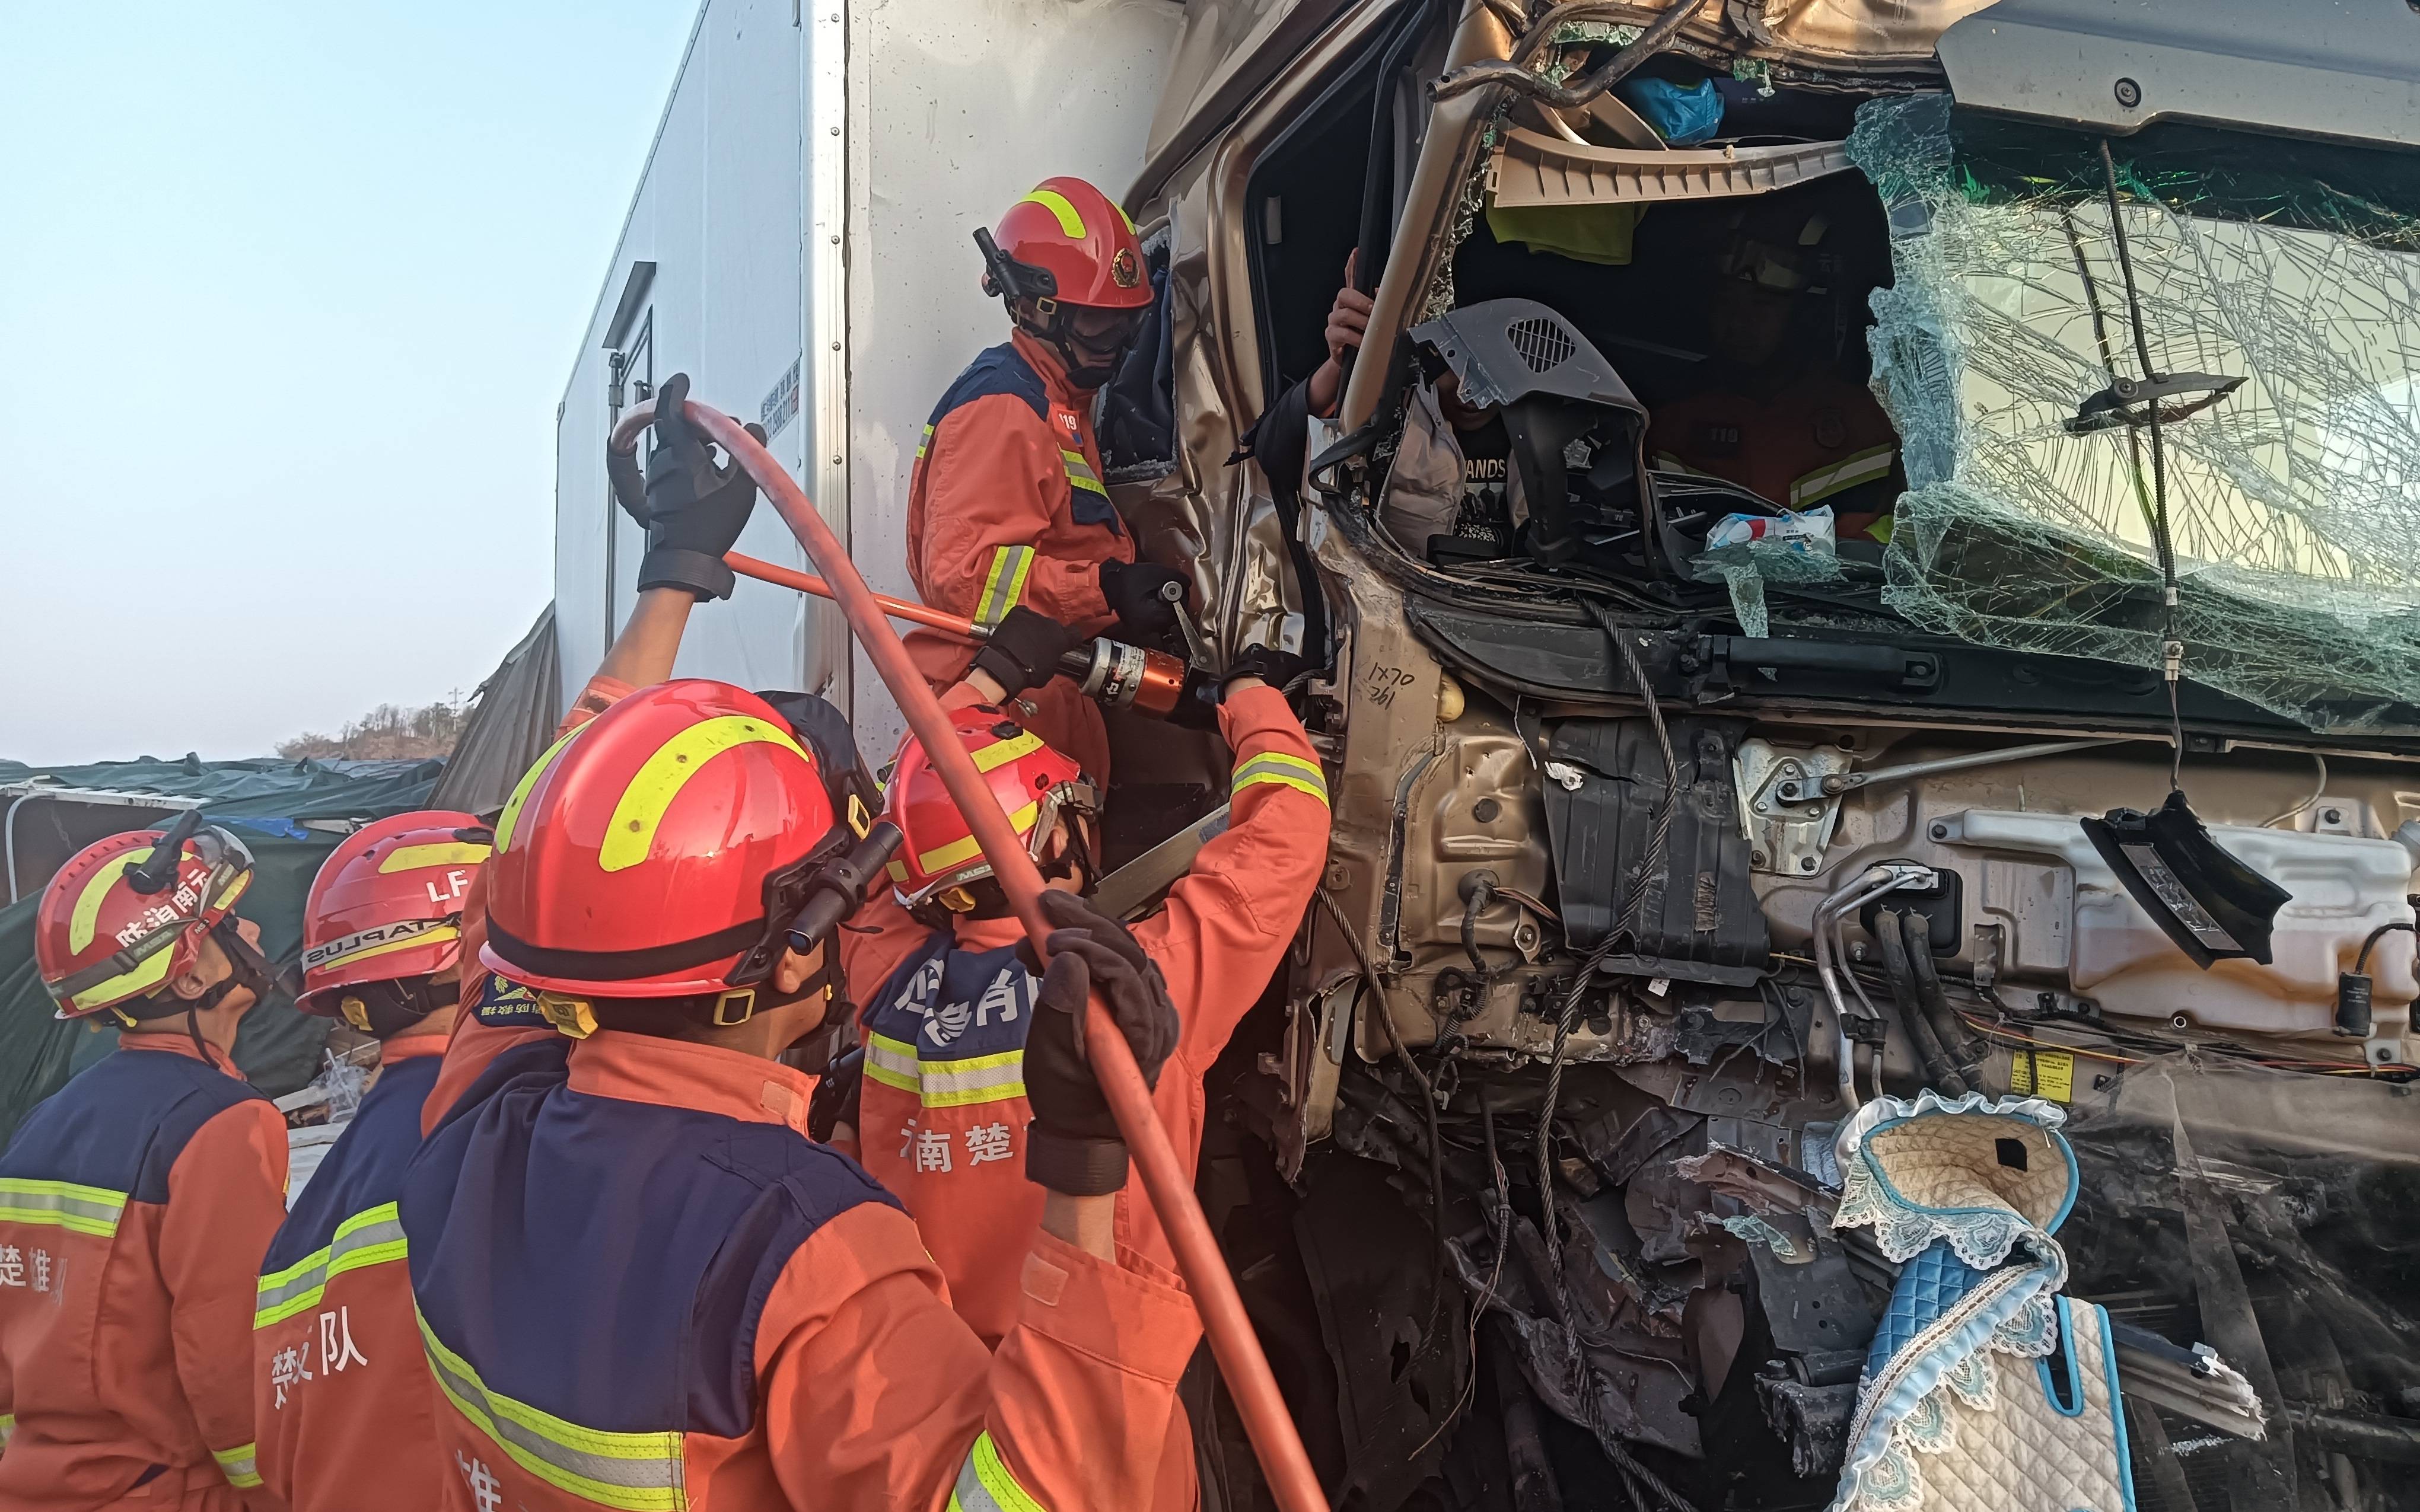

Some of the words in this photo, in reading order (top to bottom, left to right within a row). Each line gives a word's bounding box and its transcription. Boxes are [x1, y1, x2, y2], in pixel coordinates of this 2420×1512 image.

[1058, 413, 1077, 430] 119
[1709, 427, 1738, 442] 119
[1465, 459, 1506, 479] ANDS
